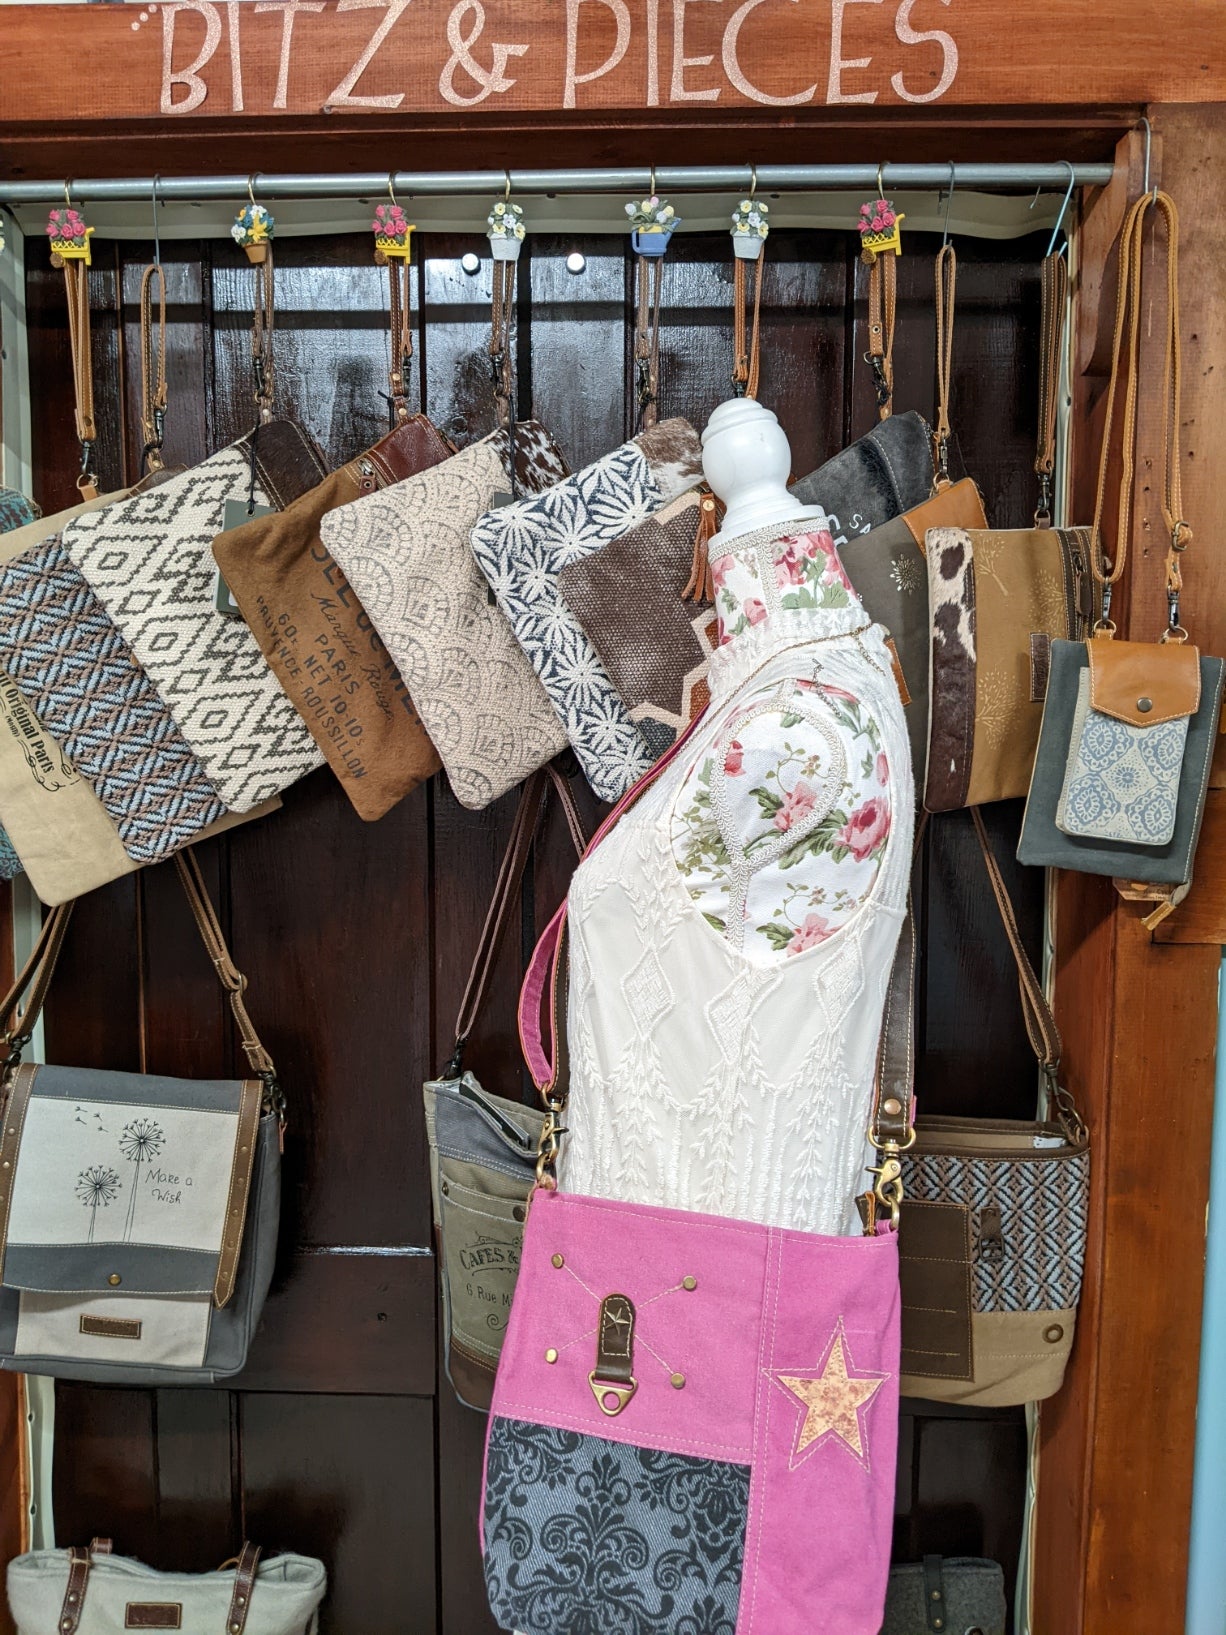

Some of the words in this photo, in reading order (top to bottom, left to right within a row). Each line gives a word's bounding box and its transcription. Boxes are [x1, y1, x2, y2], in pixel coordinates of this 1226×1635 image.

[160, 0, 409, 114] BITZ
[438, 0, 530, 107] &
[562, 0, 959, 109] PIECES
[303, 654, 333, 686] NET
[314, 632, 360, 695] PARIS
[5, 688, 42, 740] Original
[30, 737, 55, 775] Parts
[145, 1168, 180, 1185] Make
[185, 1176, 193, 1186] a
[151, 1188, 182, 1204] Wish
[477, 1285, 497, 1304] Rue
